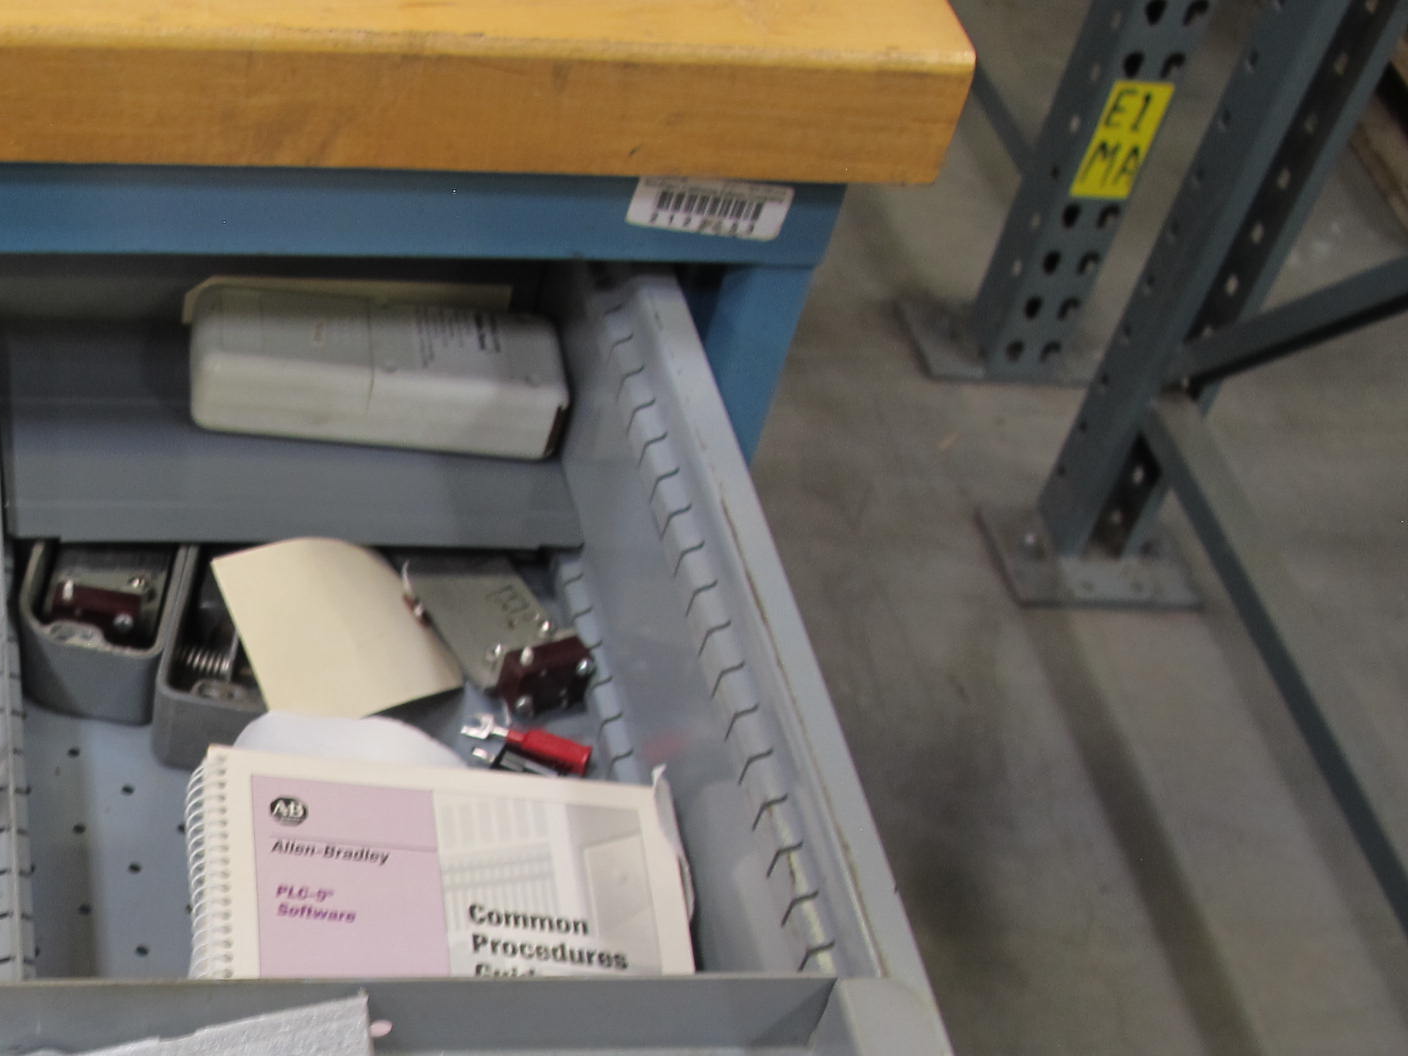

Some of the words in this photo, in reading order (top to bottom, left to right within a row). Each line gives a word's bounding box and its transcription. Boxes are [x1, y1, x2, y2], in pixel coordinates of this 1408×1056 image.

[271, 840, 389, 866] Allen-Bradley
[277, 903, 357, 923] Software
[468, 903, 590, 935] Common
[472, 934, 629, 970] Procedures
